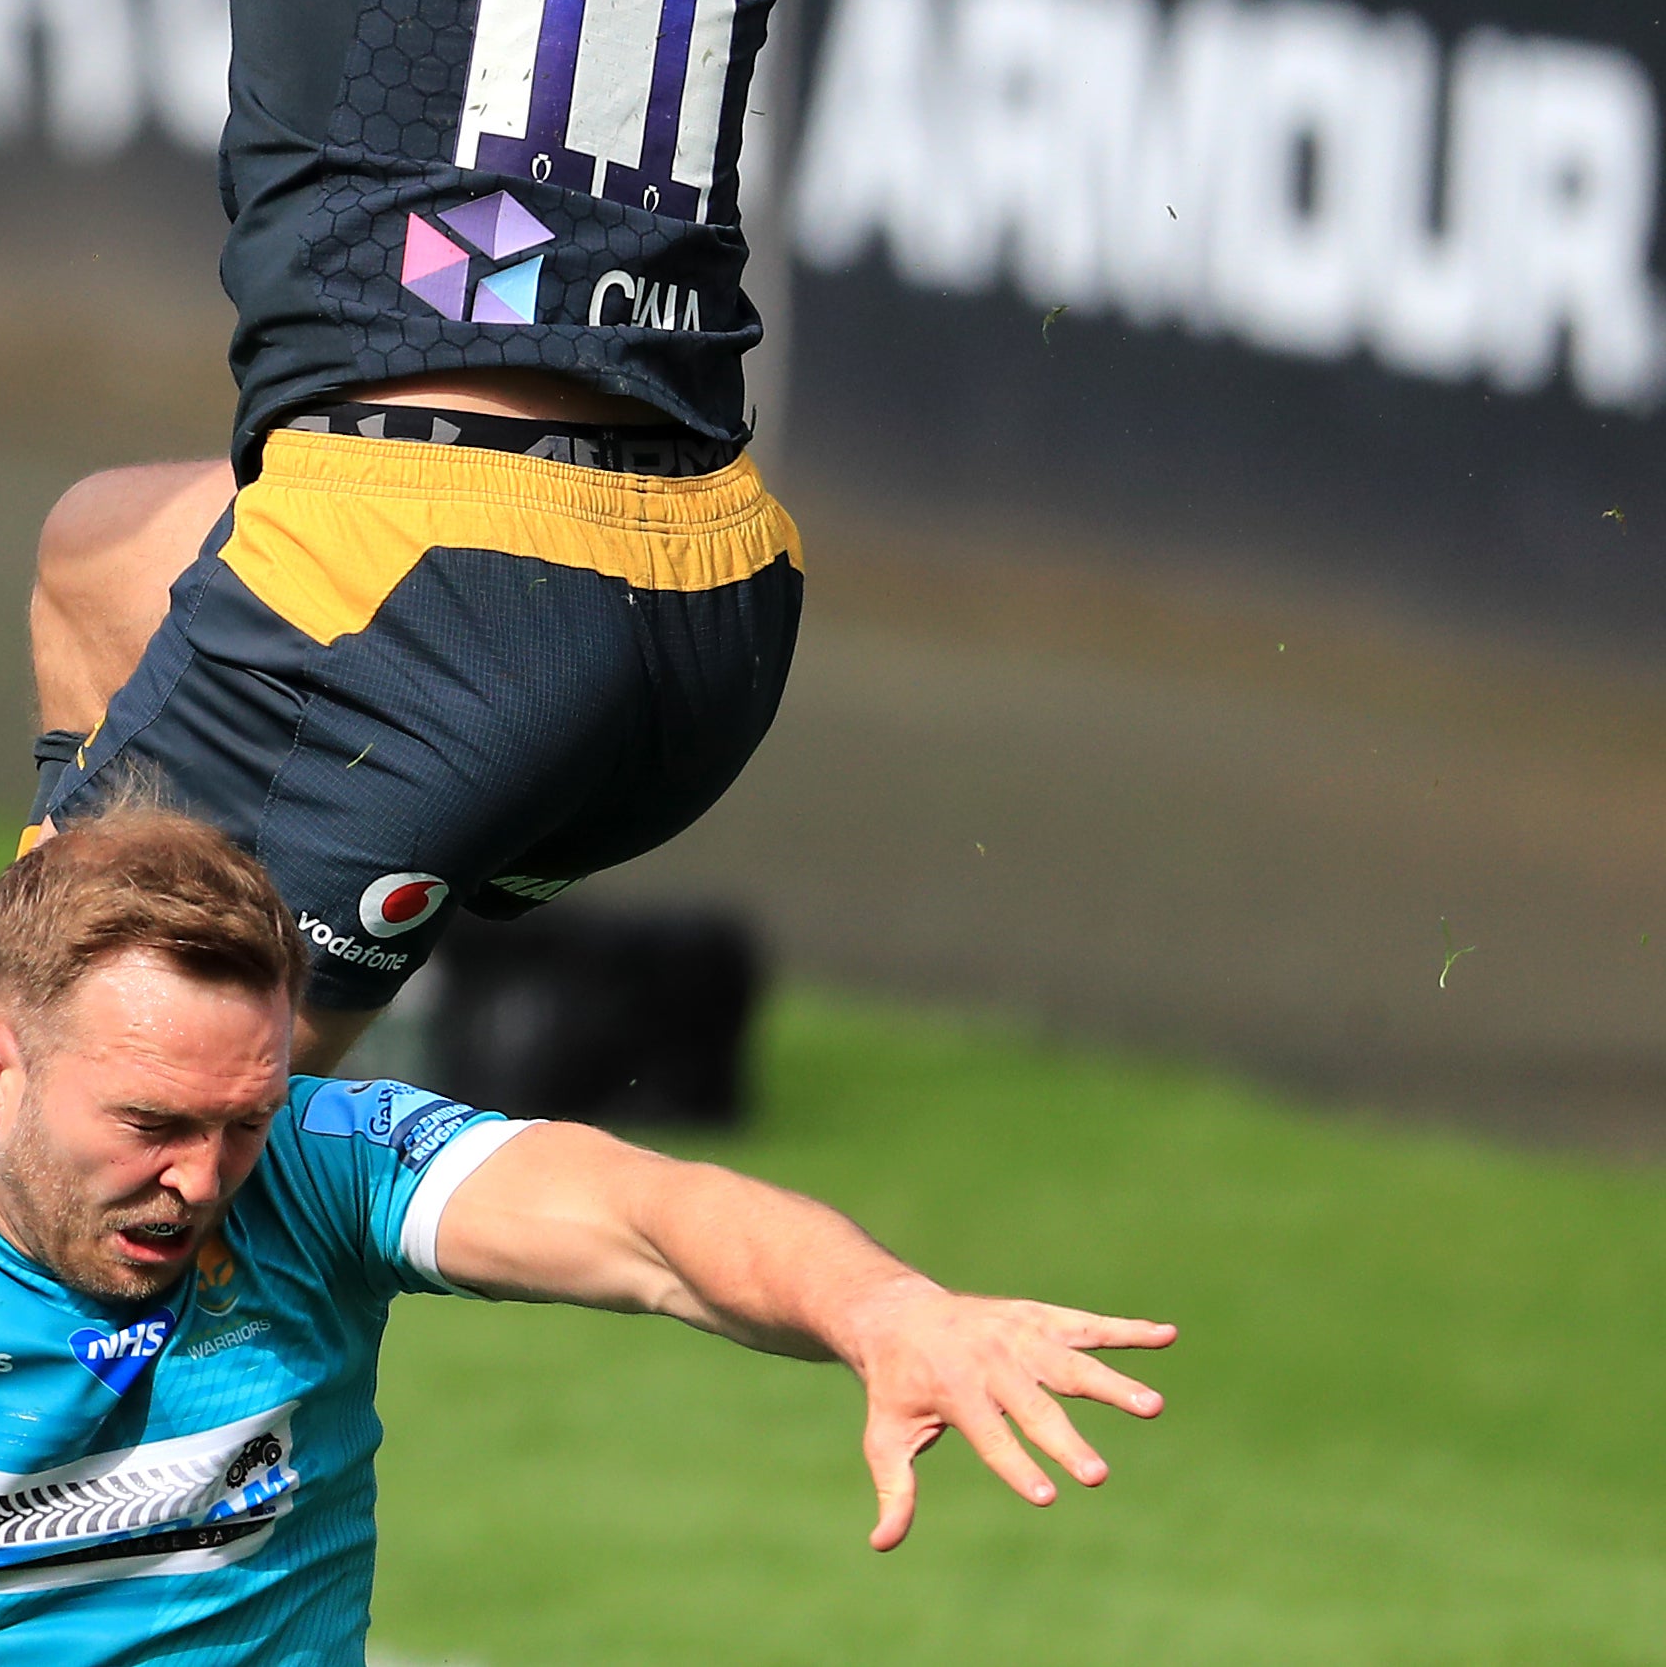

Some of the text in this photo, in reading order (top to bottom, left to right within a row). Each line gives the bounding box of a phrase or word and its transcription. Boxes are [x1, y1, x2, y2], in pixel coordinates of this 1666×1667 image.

[298, 910, 409, 971] vodafone
[88, 1321, 167, 1360] NHS
[187, 1319, 271, 1362] WARRIORS
